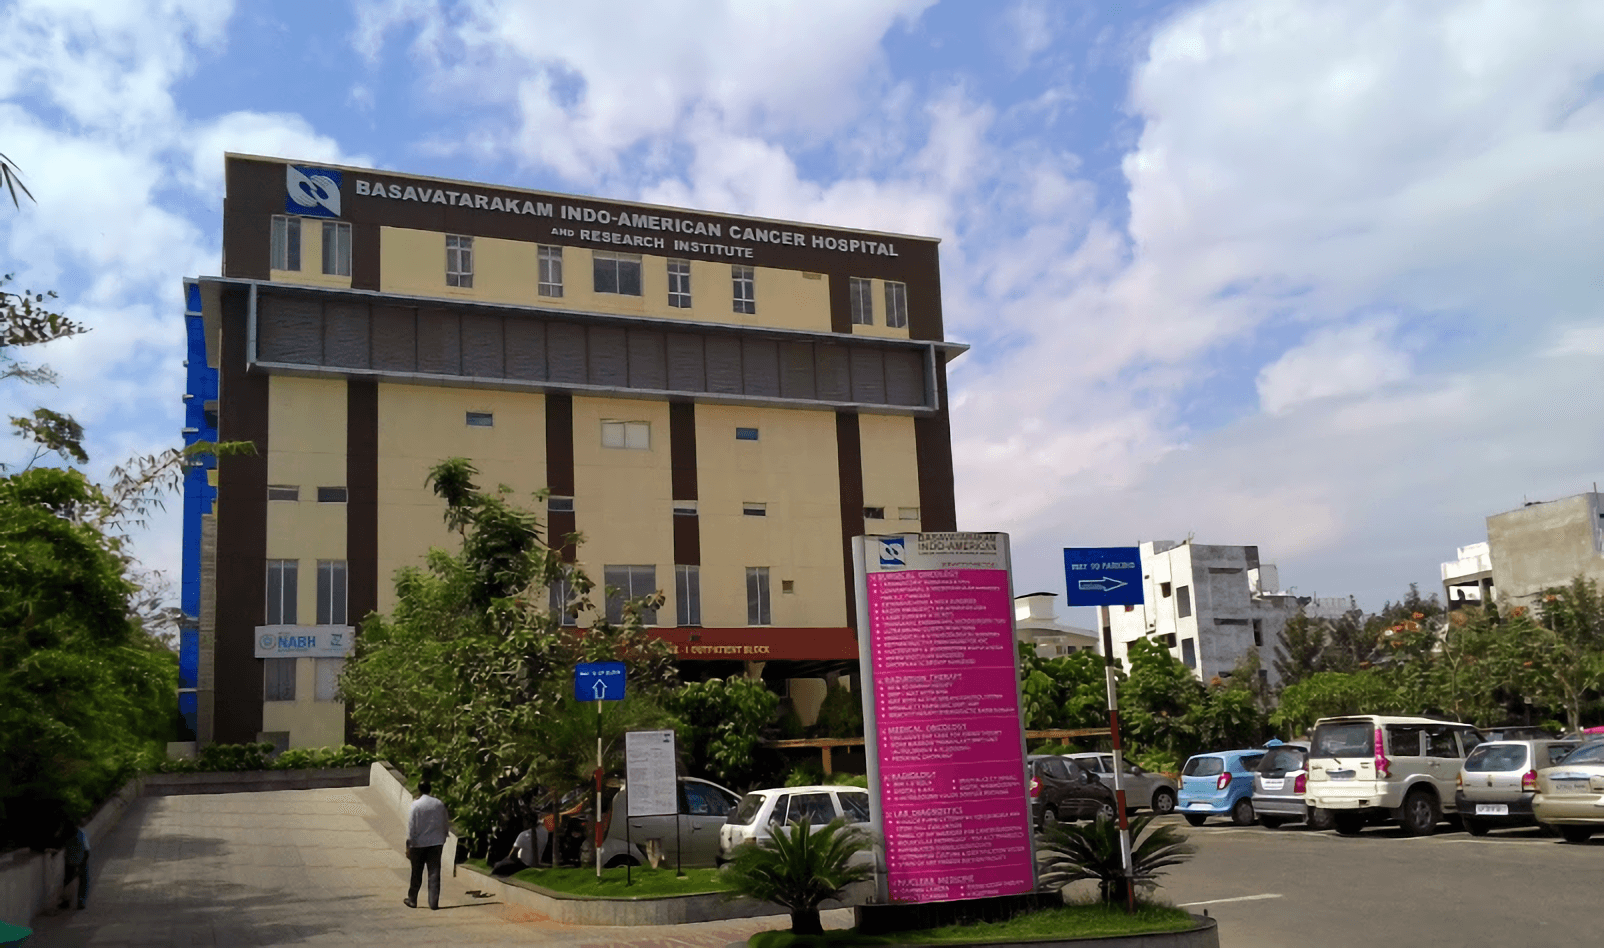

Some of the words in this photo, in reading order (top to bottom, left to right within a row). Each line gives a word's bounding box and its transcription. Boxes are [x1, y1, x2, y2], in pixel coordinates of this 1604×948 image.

[356, 180, 553, 217] BASAVATARAKAM
[561, 205, 721, 237] INDO-AMERICAN
[730, 226, 806, 246] CANCER
[812, 235, 898, 257] HOSPITAL
[551, 227, 574, 237] AND
[580, 229, 664, 249] RESEARCH
[674, 240, 754, 259] INSTITUTE
[918, 542, 996, 550] INDO-AMERICAN
[1102, 562, 1135, 570] PARKING
[279, 636, 315, 648] NABH
[744, 646, 770, 654] BLOCK
